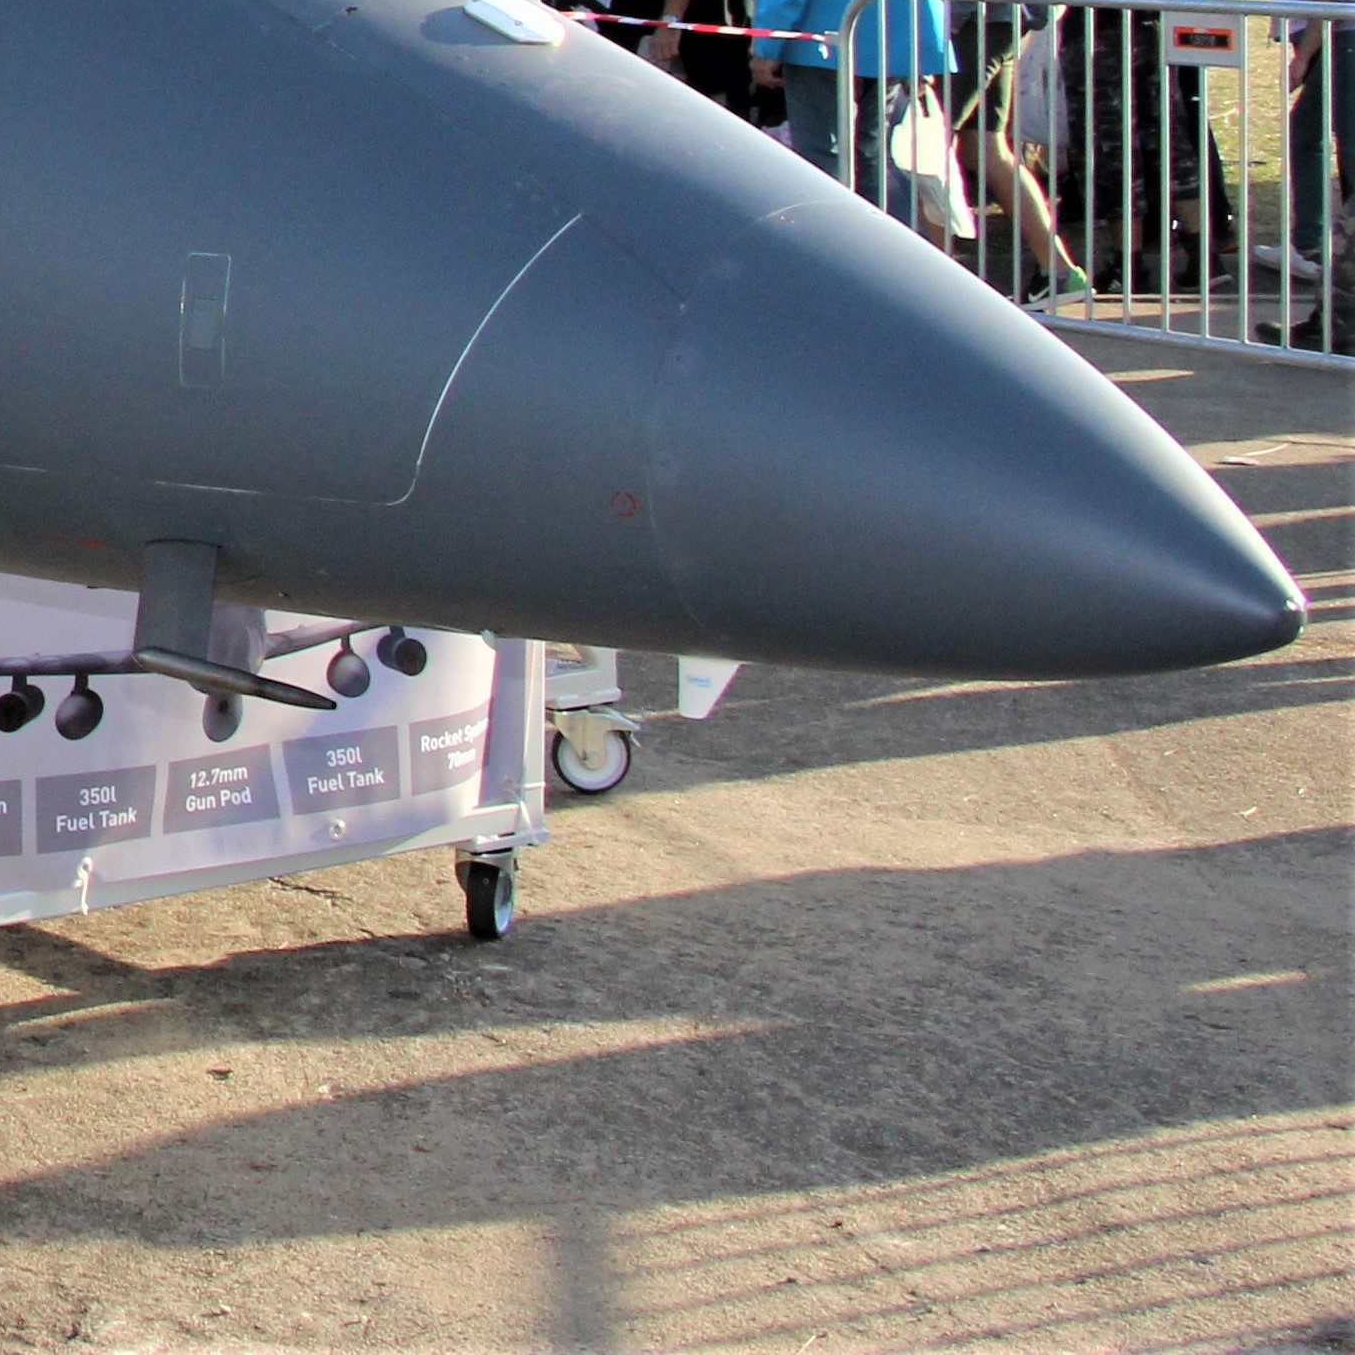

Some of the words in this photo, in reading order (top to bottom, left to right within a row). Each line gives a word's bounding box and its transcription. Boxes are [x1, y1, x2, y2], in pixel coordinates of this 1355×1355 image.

[420, 729, 463, 753] Rocket
[327, 747, 363, 768] 350l
[190, 765, 248, 789] 12.7mm
[307, 774, 344, 795] Fuel
[347, 767, 386, 788] Tank
[79, 786, 117, 807] 350l
[185, 794, 216, 813] Gun
[221, 787, 253, 806] Pod
[56, 812, 95, 833] Fuel
[99, 806, 138, 827] Tank
